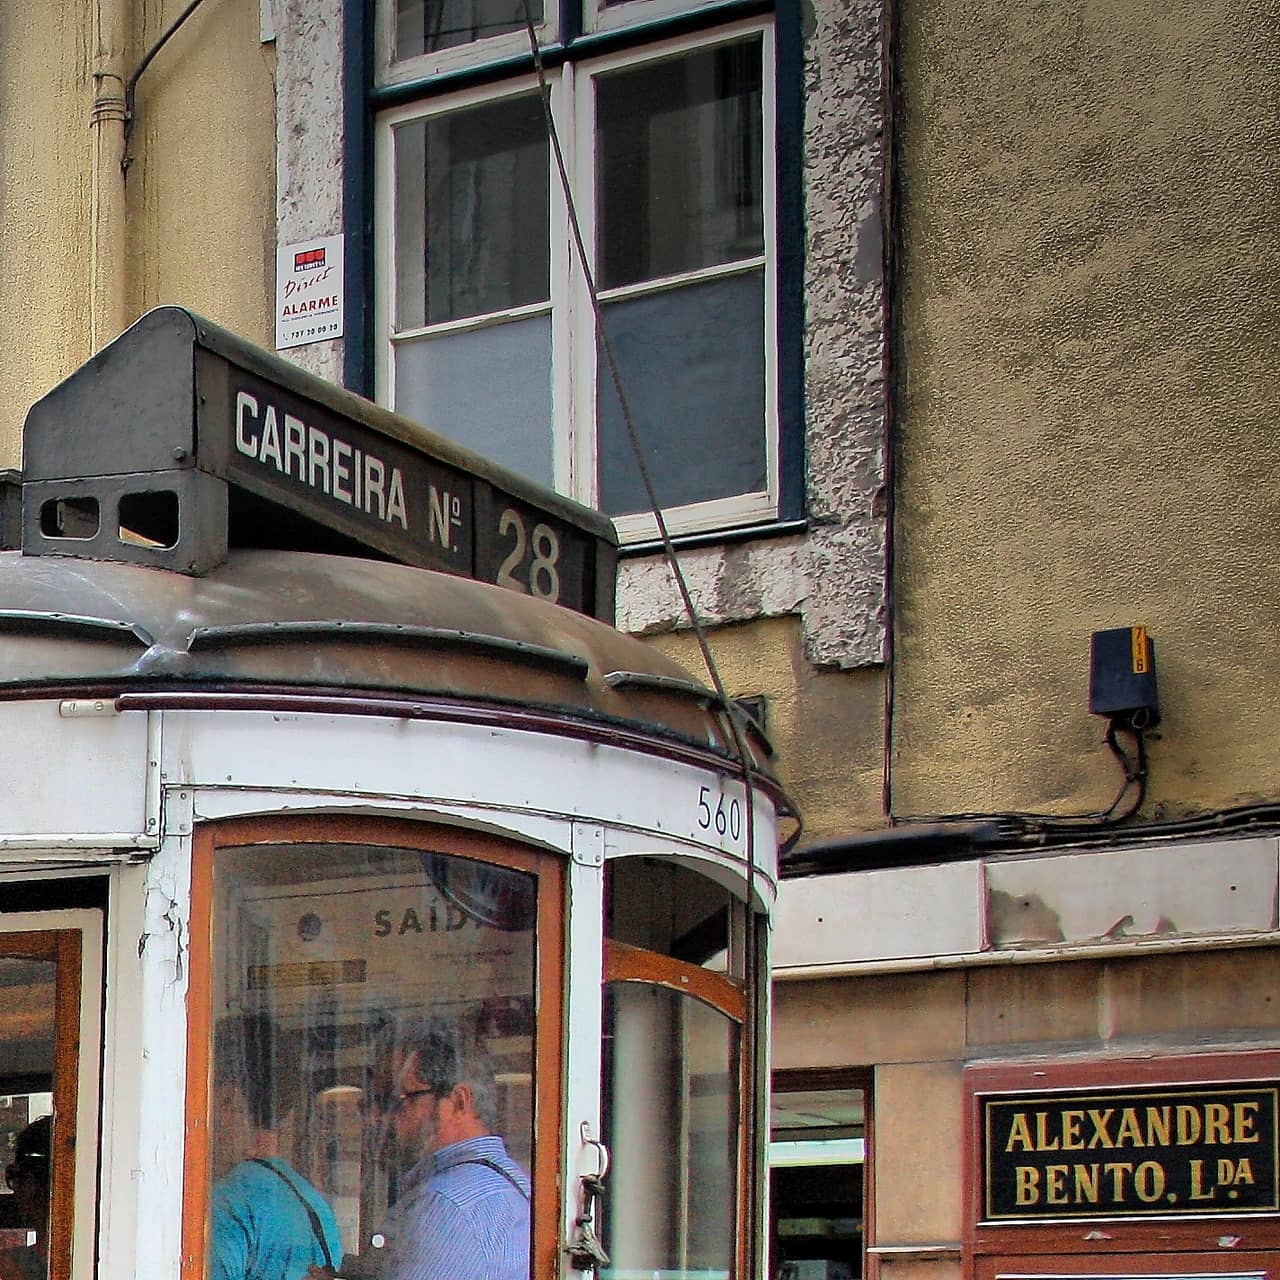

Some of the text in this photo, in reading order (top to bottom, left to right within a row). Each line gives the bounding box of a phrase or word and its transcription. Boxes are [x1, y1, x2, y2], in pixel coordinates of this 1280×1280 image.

[282, 295, 338, 316] ALARME
[236, 391, 408, 530] CARREIRA
[496, 508, 559, 605] 28
[698, 786, 741, 841] 560
[374, 897, 484, 938] SAÍD
[1005, 1102, 1259, 1152] ALEXANDRE
